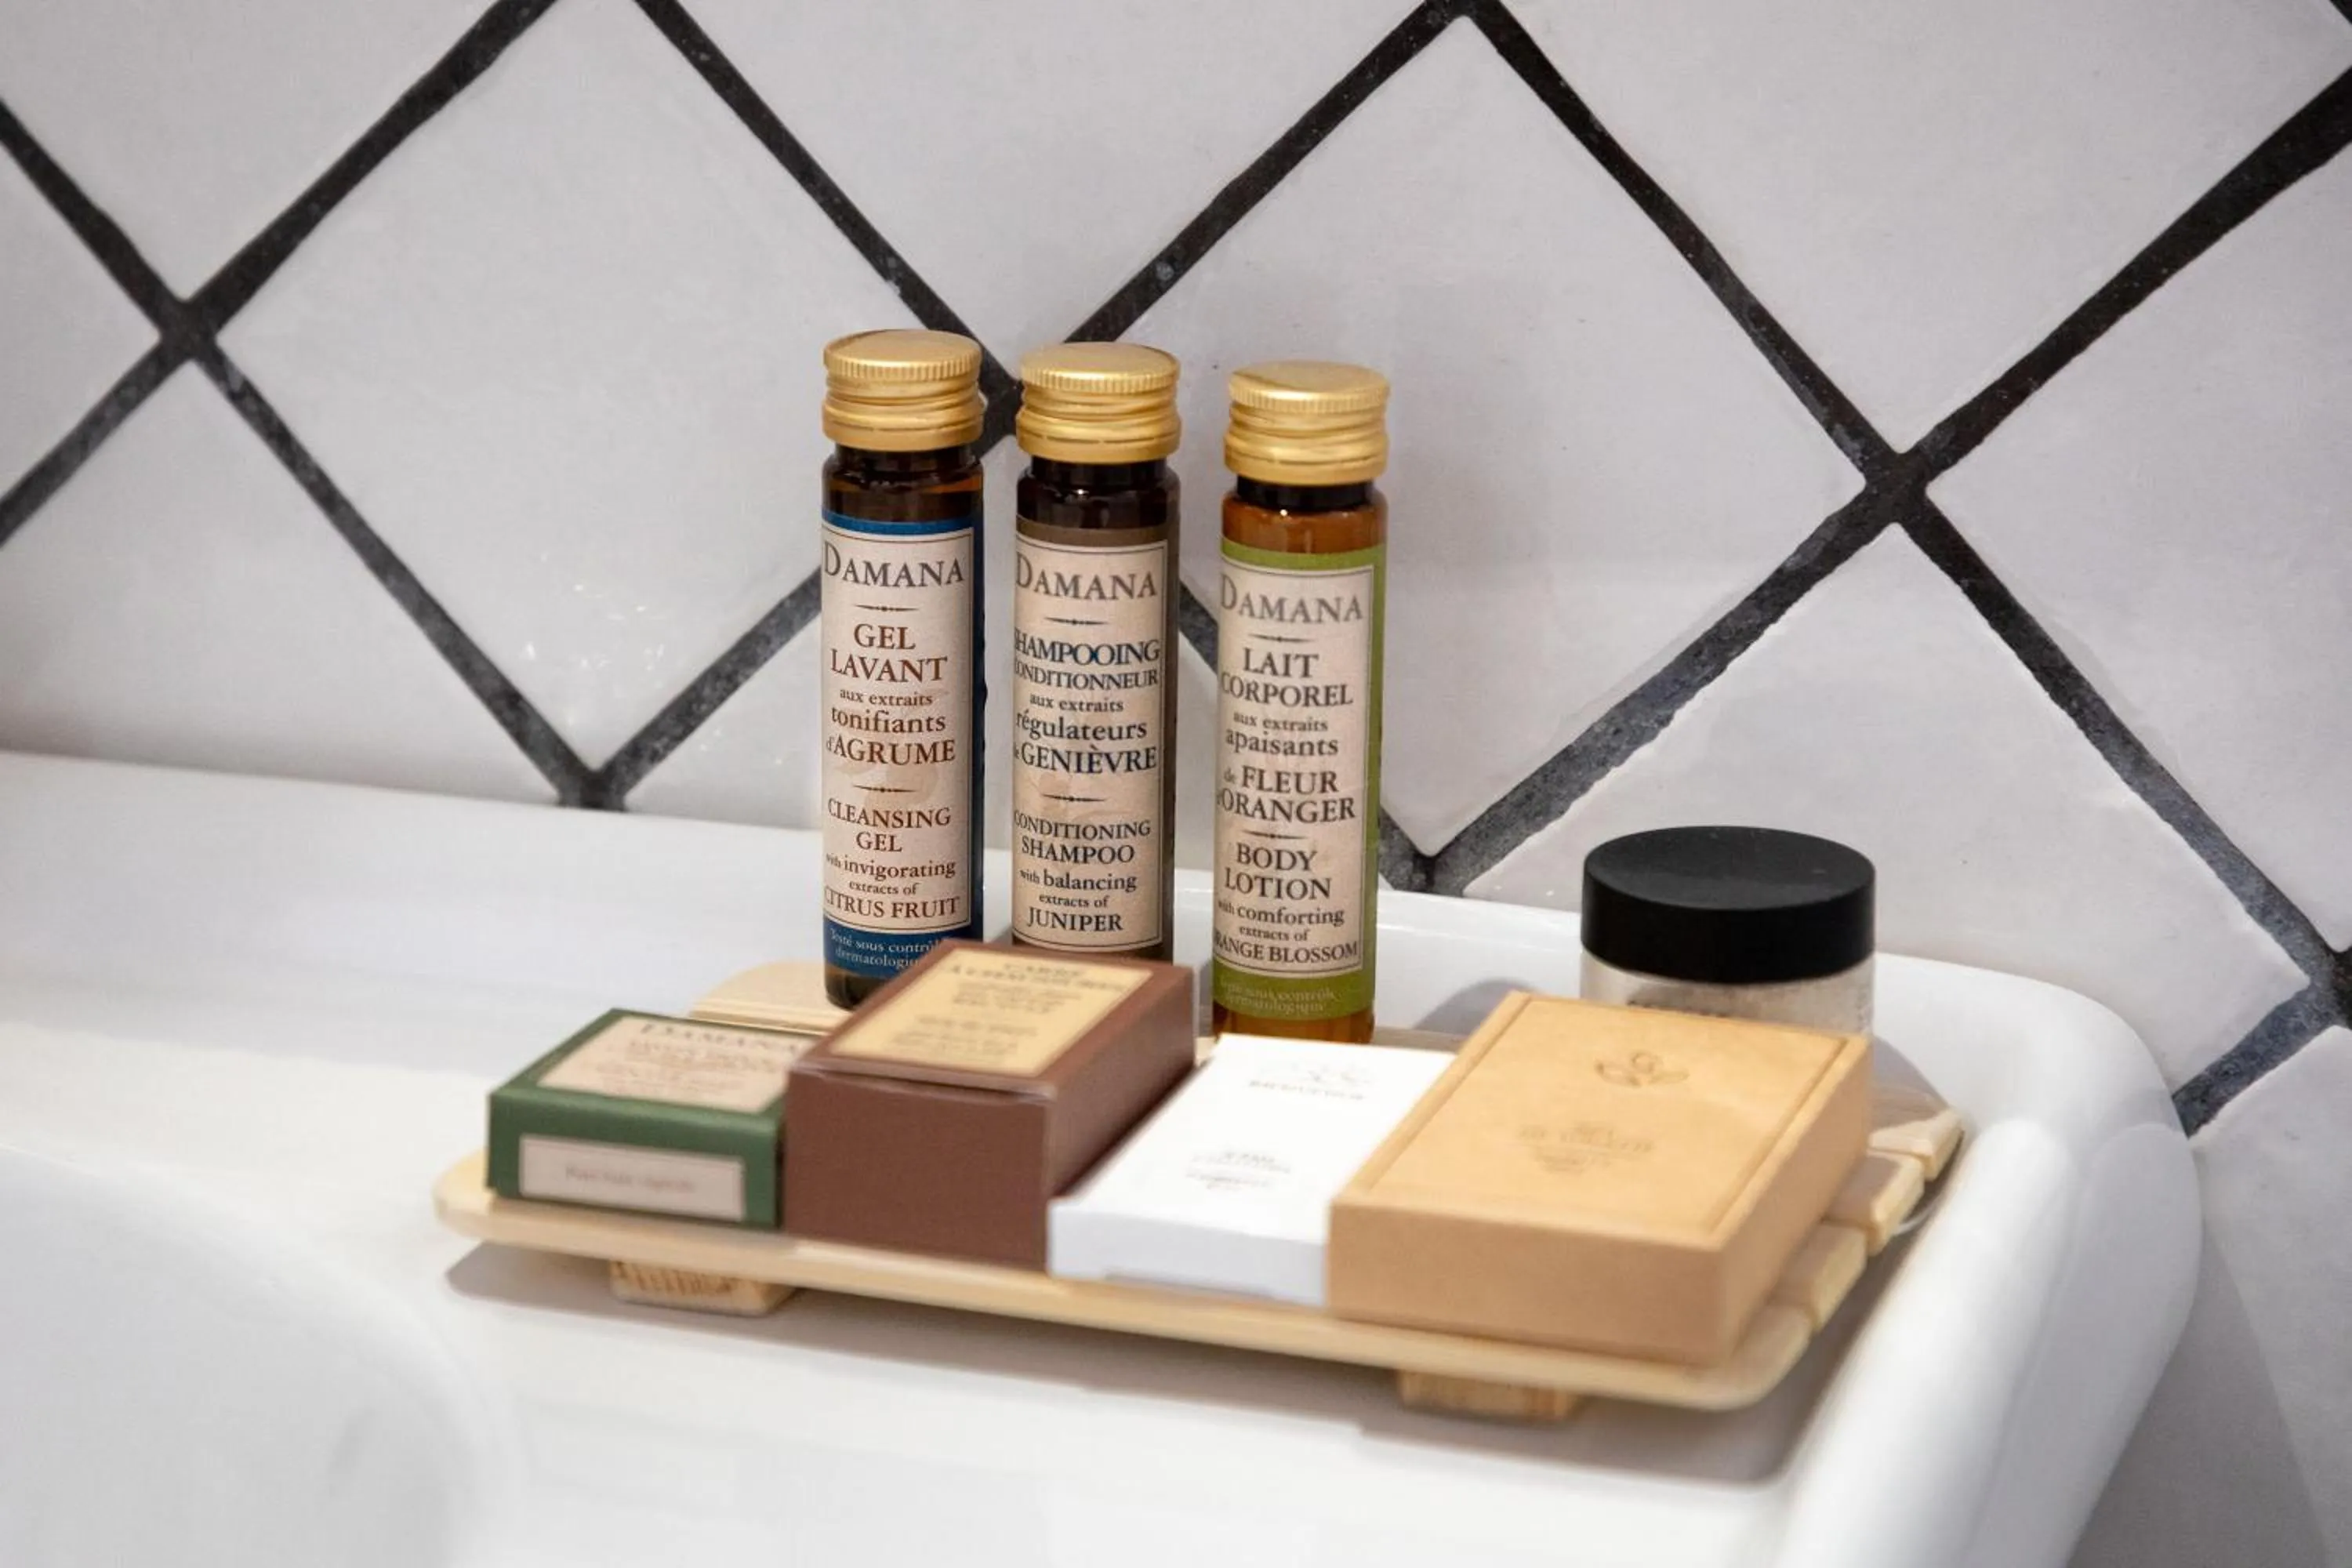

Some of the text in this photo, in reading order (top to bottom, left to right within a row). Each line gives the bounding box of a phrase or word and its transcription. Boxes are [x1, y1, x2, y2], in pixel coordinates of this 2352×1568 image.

[824, 540, 965, 587] DAMANA
[1016, 550, 1157, 601] DAMANA
[1220, 572, 1363, 623] DAMANA
[854, 622, 916, 650] GEL
[831, 648, 948, 683] LAVANT
[1243, 647, 1319, 679] LAIT
[840, 688, 934, 706] aux extraits
[1029, 693, 1124, 713] aux extraits
[1220, 671, 1354, 708] CORPOREL
[831, 706, 946, 734] tonifiants
[1016, 708, 1148, 741] régulateurs
[1233, 711, 1329, 732] aux extraits
[826, 734, 956, 766] d'AGRUME
[1225, 728, 1339, 757] apaisants
[1022, 742, 1157, 775] GENIÈVRE
[1241, 764, 1340, 795] FLEUR
[828, 797, 951, 829] CLEANSING
[855, 831, 902, 853] GEL
[1022, 835, 1135, 865] SHAMPOO
[844, 855, 956, 881] invigorating
[1236, 842, 1318, 873] BODY
[849, 880, 920, 895] extracts of
[1019, 868, 1138, 893] with balancing
[1225, 867, 1333, 901] LOTION
[823, 885, 960, 919] CITRUS FRUIT
[1039, 893, 1110, 909] extracts of
[1026, 906, 1124, 932] JUNIPER
[1236, 906, 1345, 928] comforting
[1214, 928, 1358, 964] RANGE BLOSSOM
[1239, 925, 1311, 942] extracts of
